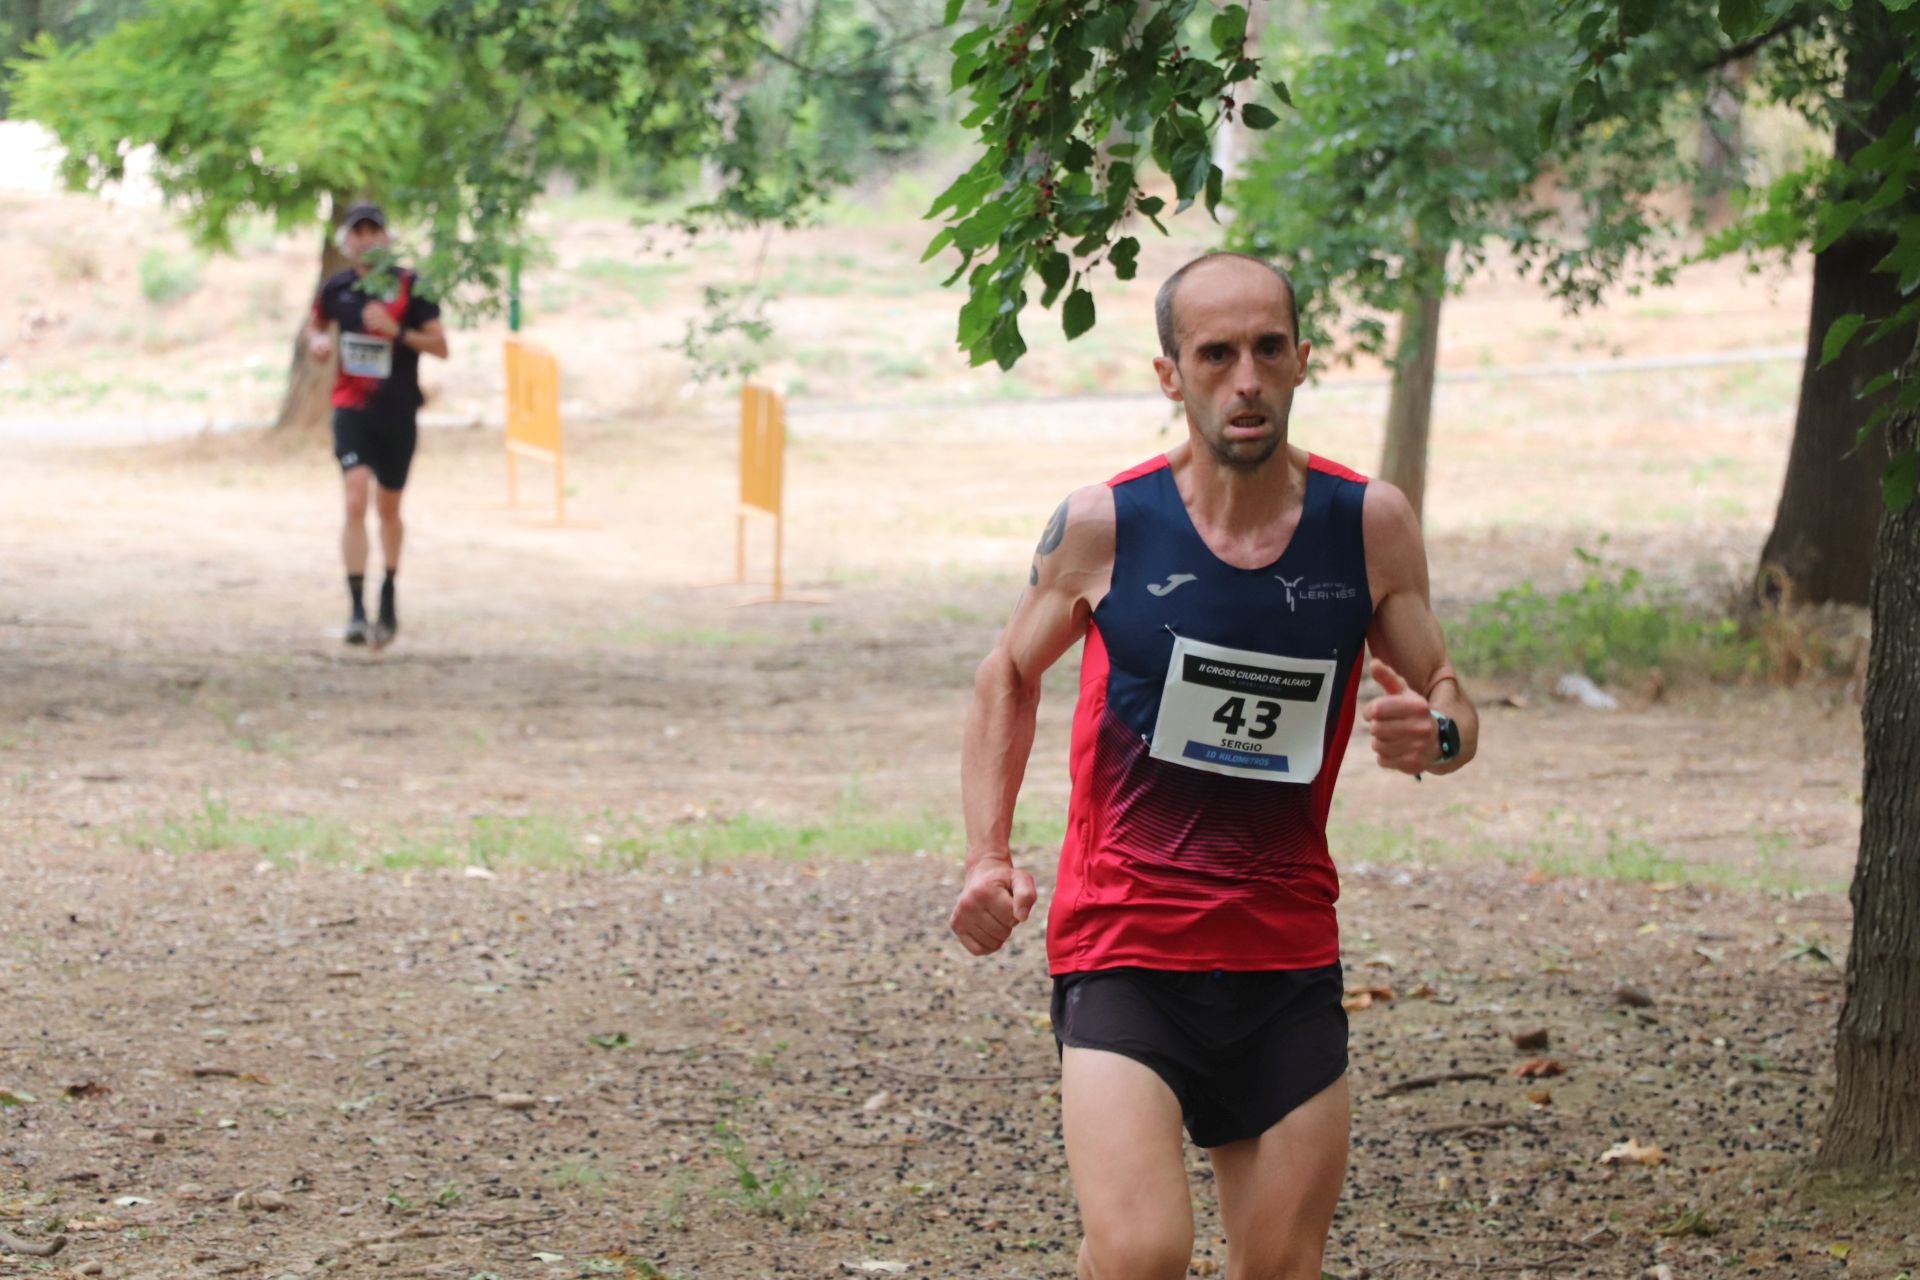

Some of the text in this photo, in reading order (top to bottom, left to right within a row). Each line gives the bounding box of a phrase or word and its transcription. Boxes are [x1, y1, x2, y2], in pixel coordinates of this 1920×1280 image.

[1206, 665, 1235, 678] CROSS
[1236, 671, 1268, 682] CIUDAD
[1268, 675, 1282, 684] DE
[1282, 678, 1311, 687] ALFARO
[1212, 696, 1282, 740] 43
[1220, 738, 1263, 752] SERGIO
[1206, 750, 1269, 766] 10 KILOMETROS
